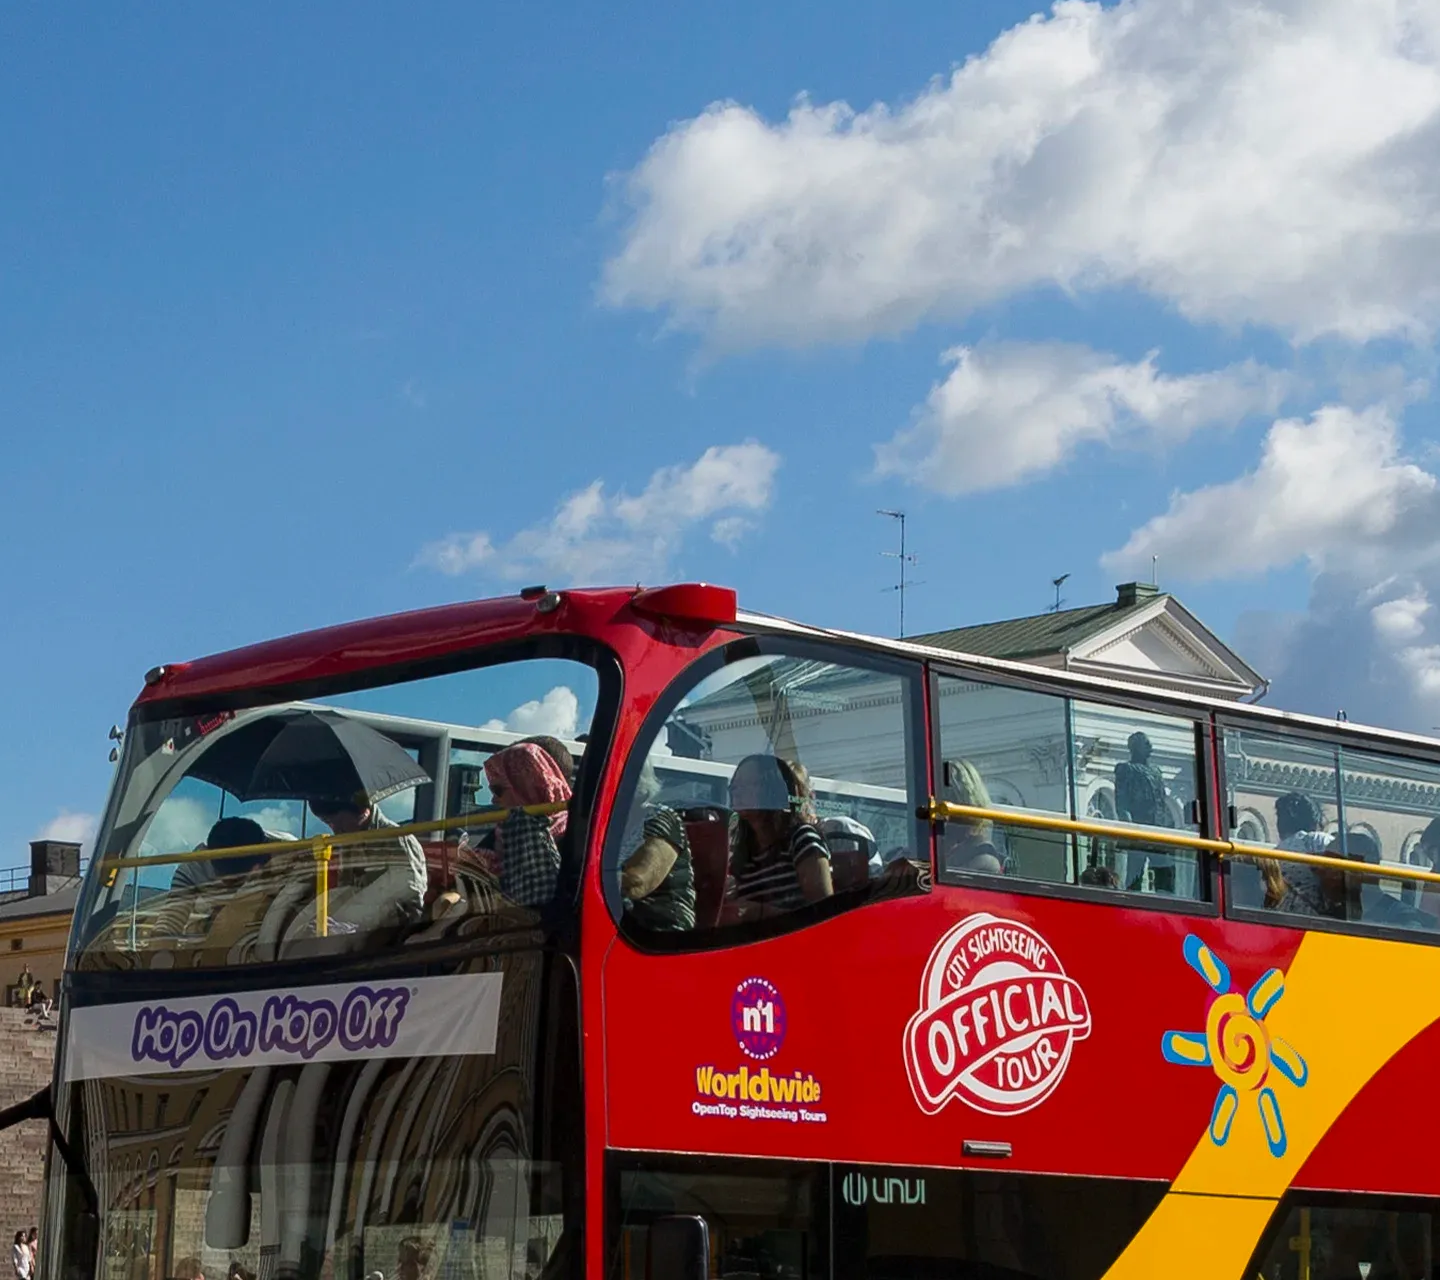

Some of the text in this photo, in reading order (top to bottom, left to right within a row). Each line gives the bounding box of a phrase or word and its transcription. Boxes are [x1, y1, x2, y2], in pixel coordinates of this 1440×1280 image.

[946, 928, 1048, 989] CITY SIGHTSEEING
[132, 986, 410, 1068] Hop On Hop Off
[928, 981, 1084, 1076] OFFICIAL
[696, 1066, 821, 1103] Worldwide
[994, 1037, 1059, 1089] TOUR
[739, 1105, 798, 1122] Sightseeing
[799, 1109, 827, 1122] Tours
